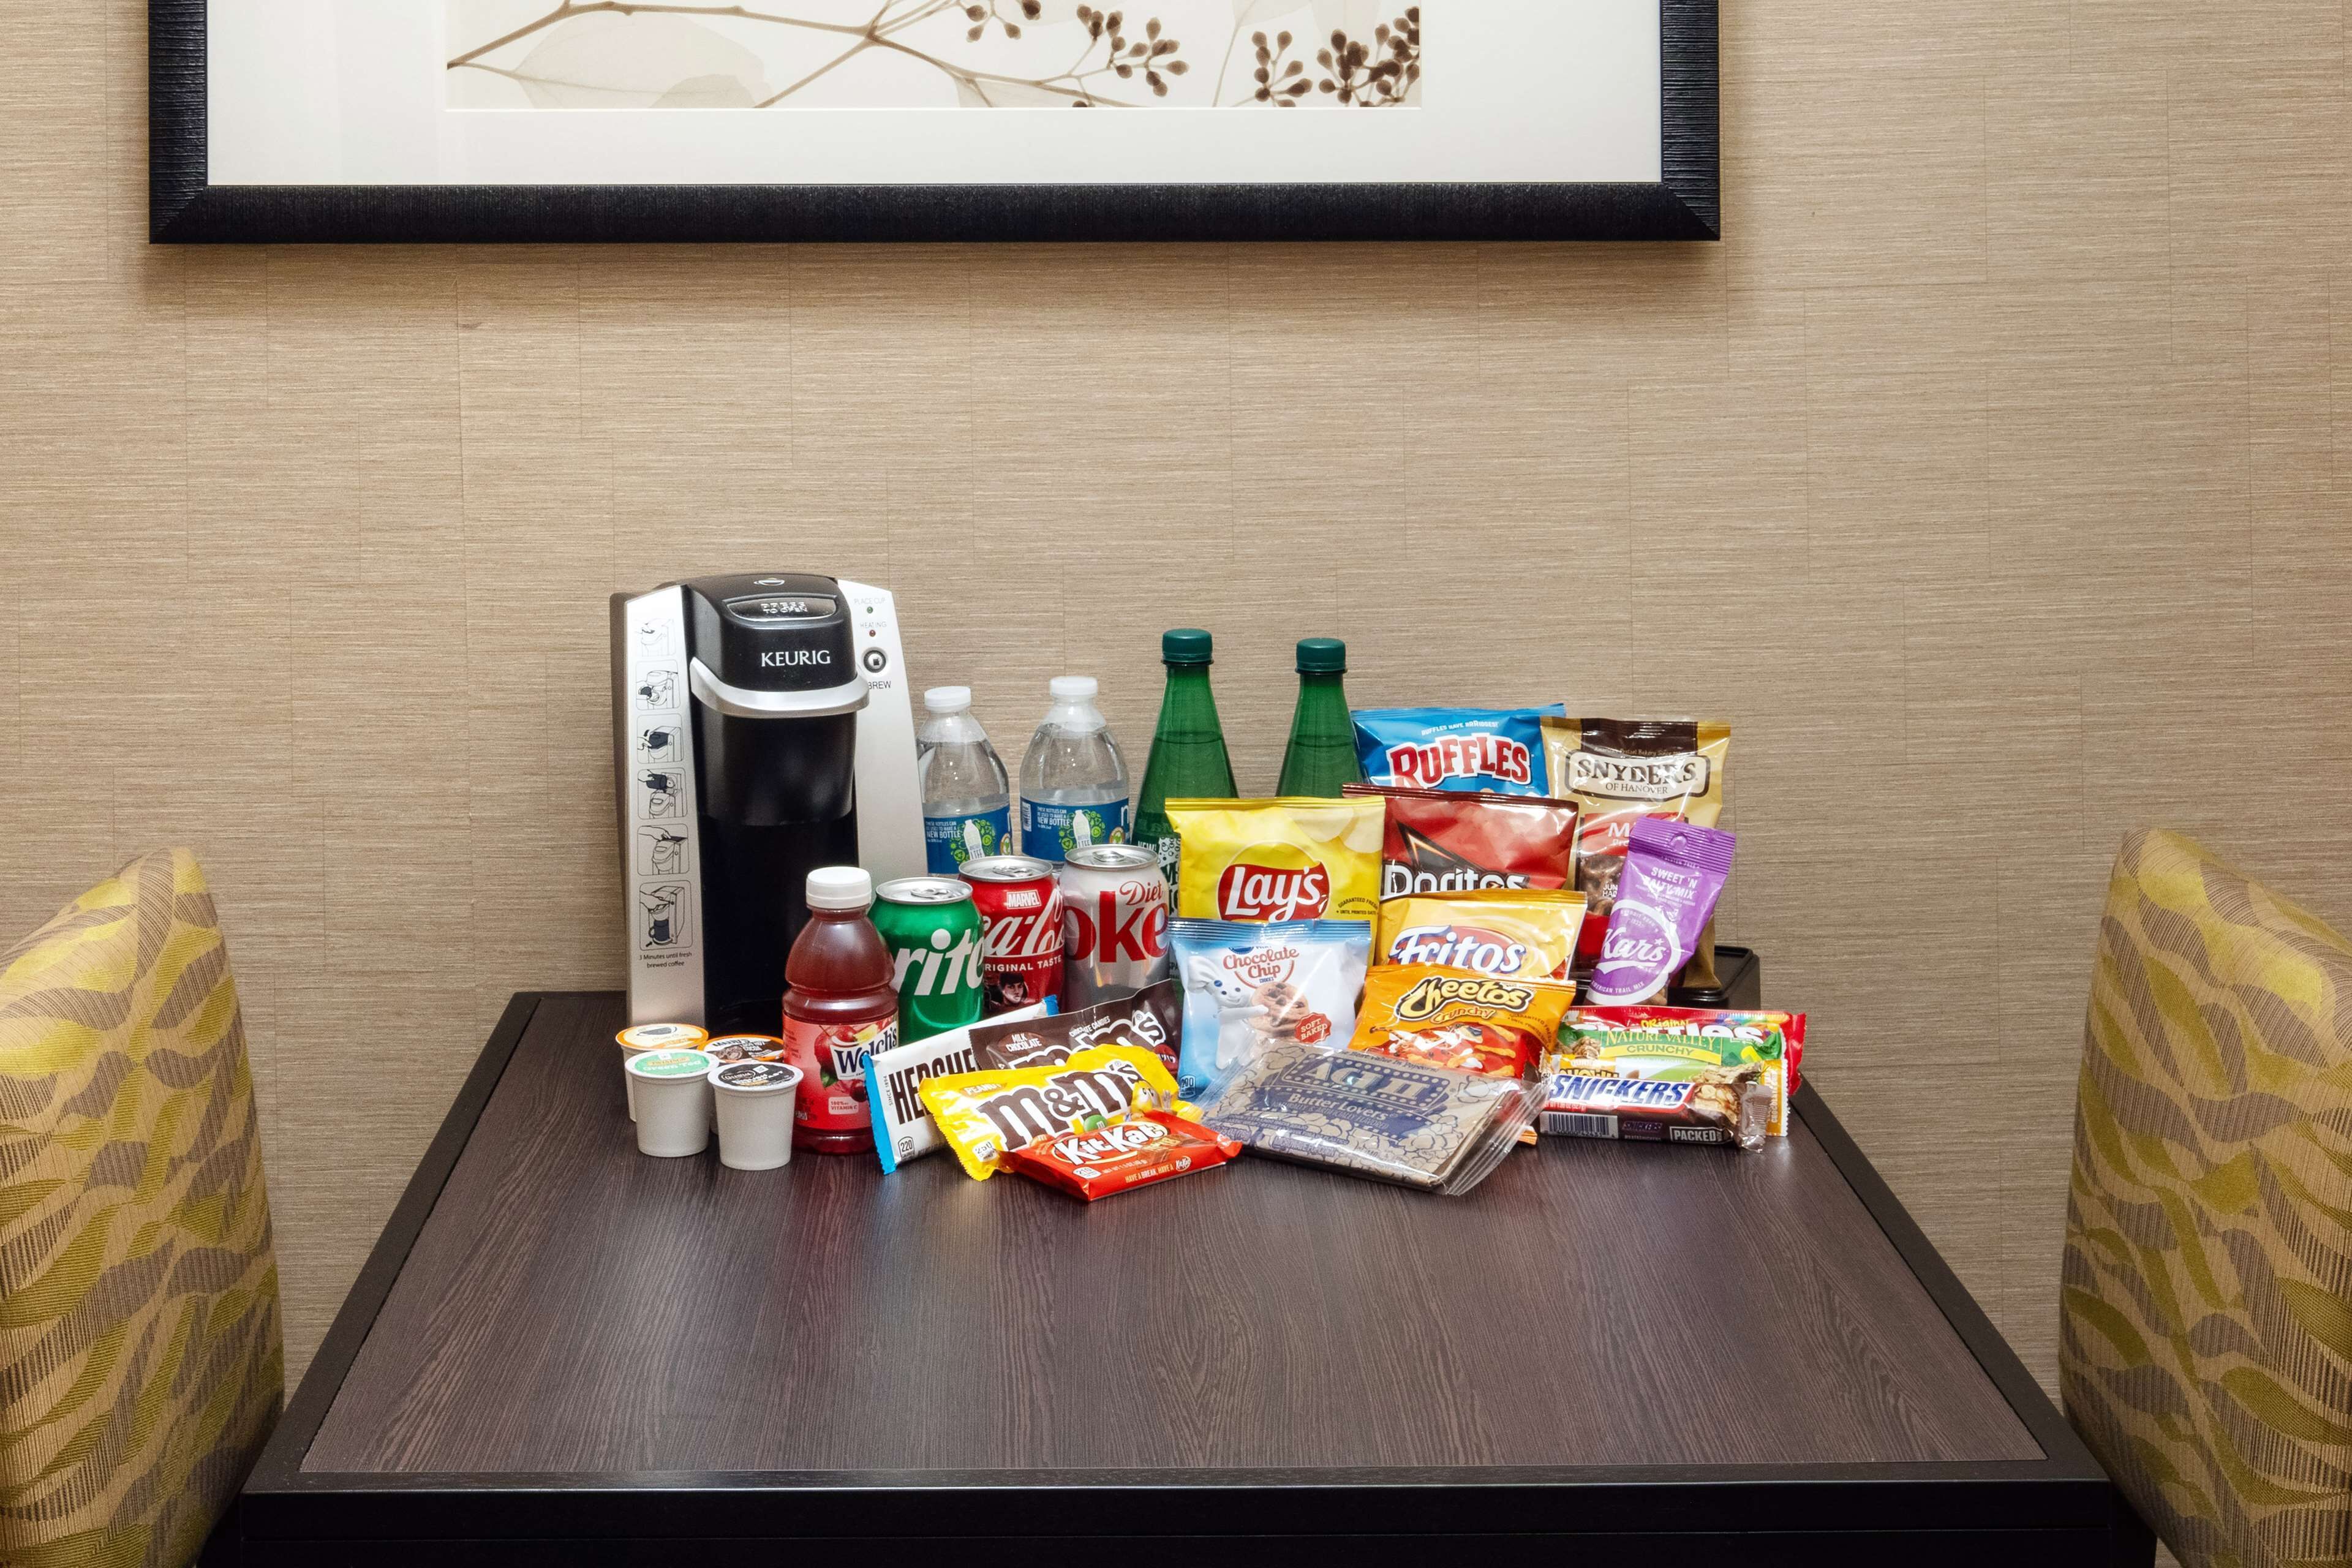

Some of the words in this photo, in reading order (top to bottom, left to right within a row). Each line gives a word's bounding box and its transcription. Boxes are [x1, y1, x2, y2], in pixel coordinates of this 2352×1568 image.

[761, 650, 831, 667] KEURIG
[1421, 725, 1447, 736] RUFFLES
[1389, 736, 1529, 789] RUFFLES
[1605, 782, 1617, 791] OF
[1621, 783, 1668, 794] HANOVER
[1384, 864, 1528, 895] Doritos
[1651, 867, 1685, 884] SWEET
[1688, 877, 1698, 889] 'N
[1008, 891, 1040, 908] MARVEL
[1120, 880, 1163, 905] Diet
[1225, 866, 1324, 922] Lay's
[1675, 887, 1695, 899] MIX
[1338, 897, 1366, 908] GUARANTEED
[1064, 891, 1169, 963] oke
[1223, 946, 1300, 970] Chocolate
[1389, 925, 1528, 974] Fritos
[889, 928, 984, 995] rite
[984, 963, 1034, 971] RIGINAL
[1037, 955, 1061, 969] TASTE
[1248, 963, 1281, 979] Chip
[1633, 981, 1645, 990] MIX
[1400, 978, 1527, 1018] Cheetos
[1093, 1016, 1110, 1030] CANDIES
[1430, 1006, 1496, 1024] Crunchy
[1300, 1018, 1321, 1033] SOFT
[1301, 1023, 1328, 1041] BAKED
[1005, 1038, 1042, 1053] CHOCOLATE
[1011, 1033, 1027, 1042] MILK
[1607, 1030, 1661, 1046] NATURE
[1665, 1033, 1716, 1051] VALLEY
[1626, 1045, 1695, 1057] CRUNCHY
[1403, 1060, 1438, 1072] Popcorn!
[1301, 1061, 1383, 1089] ACT
[964, 1083, 1001, 1096] PEANUT
[1549, 1074, 1691, 1105] SNICKERS
[976, 1063, 1144, 1151] m&m's
[1289, 1093, 1335, 1108] Butter
[1341, 1102, 1390, 1121] Lovers
[1358, 1114, 1389, 1130] FLAVORED
[1674, 1130, 1716, 1142] PACKED
[900, 1140, 913, 1153] 220
[975, 1141, 993, 1154] 250
[1054, 1124, 1166, 1166] KitKat
[1125, 1173, 1139, 1183] HAVE
[1138, 1172, 1142, 1181] A
[1142, 1169, 1157, 1180] BREAK,
[1158, 1167, 1169, 1177] HAVE
